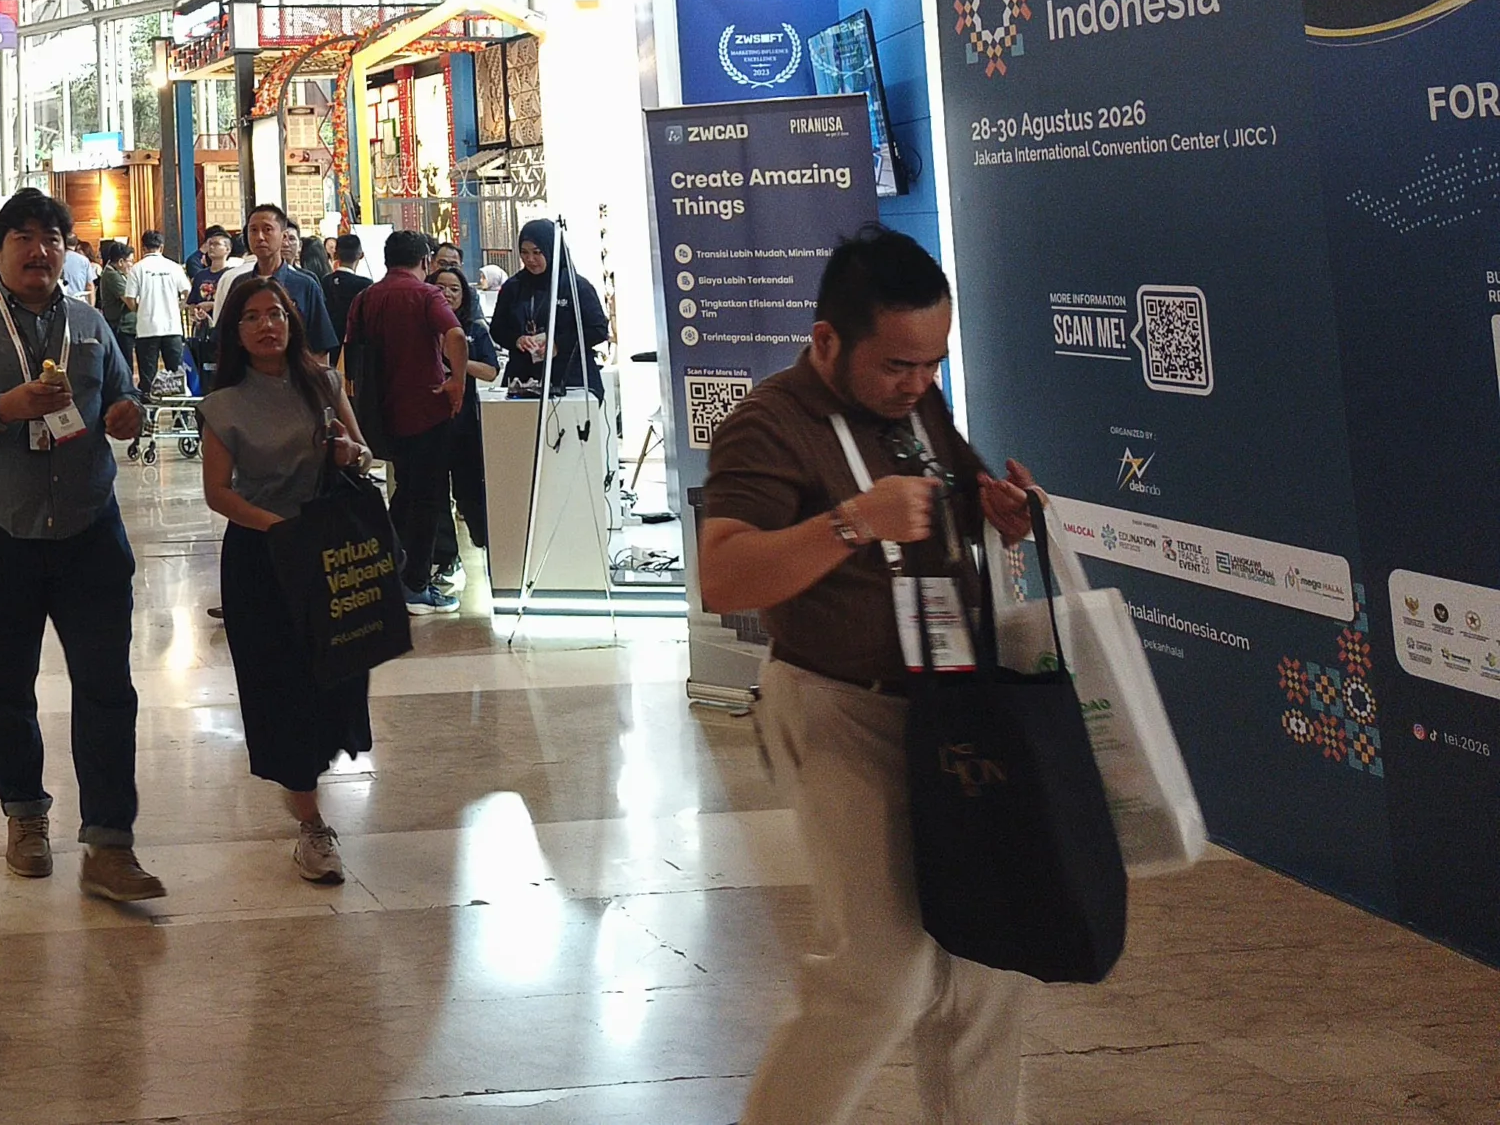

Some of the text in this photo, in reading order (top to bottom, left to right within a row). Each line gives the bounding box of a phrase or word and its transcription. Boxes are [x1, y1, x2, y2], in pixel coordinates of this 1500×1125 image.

[688, 116, 843, 142] ZWCAD PIRANUSA
[971, 100, 1146, 142] 28-30 Agustus 2026
[973, 149, 1013, 166] Jakarta
[1015, 141, 1090, 163] International
[1092, 136, 1168, 158] Convention
[1171, 131, 1220, 152] Center
[671, 164, 851, 189] Create Amazing
[672, 196, 745, 220] Things
[730, 249, 753, 258] Lebih
[724, 276, 746, 284] Lebih
[700, 300, 803, 309] Tingkatkan dan
[1050, 293, 1126, 306] MORE INFORMATION
[701, 310, 717, 318] Tim
[703, 333, 753, 343] Terintegrasi
[755, 334, 790, 344] dengan
[1053, 314, 1127, 349] SCAN ME!
[1444, 732, 1490, 757] tei.2026
